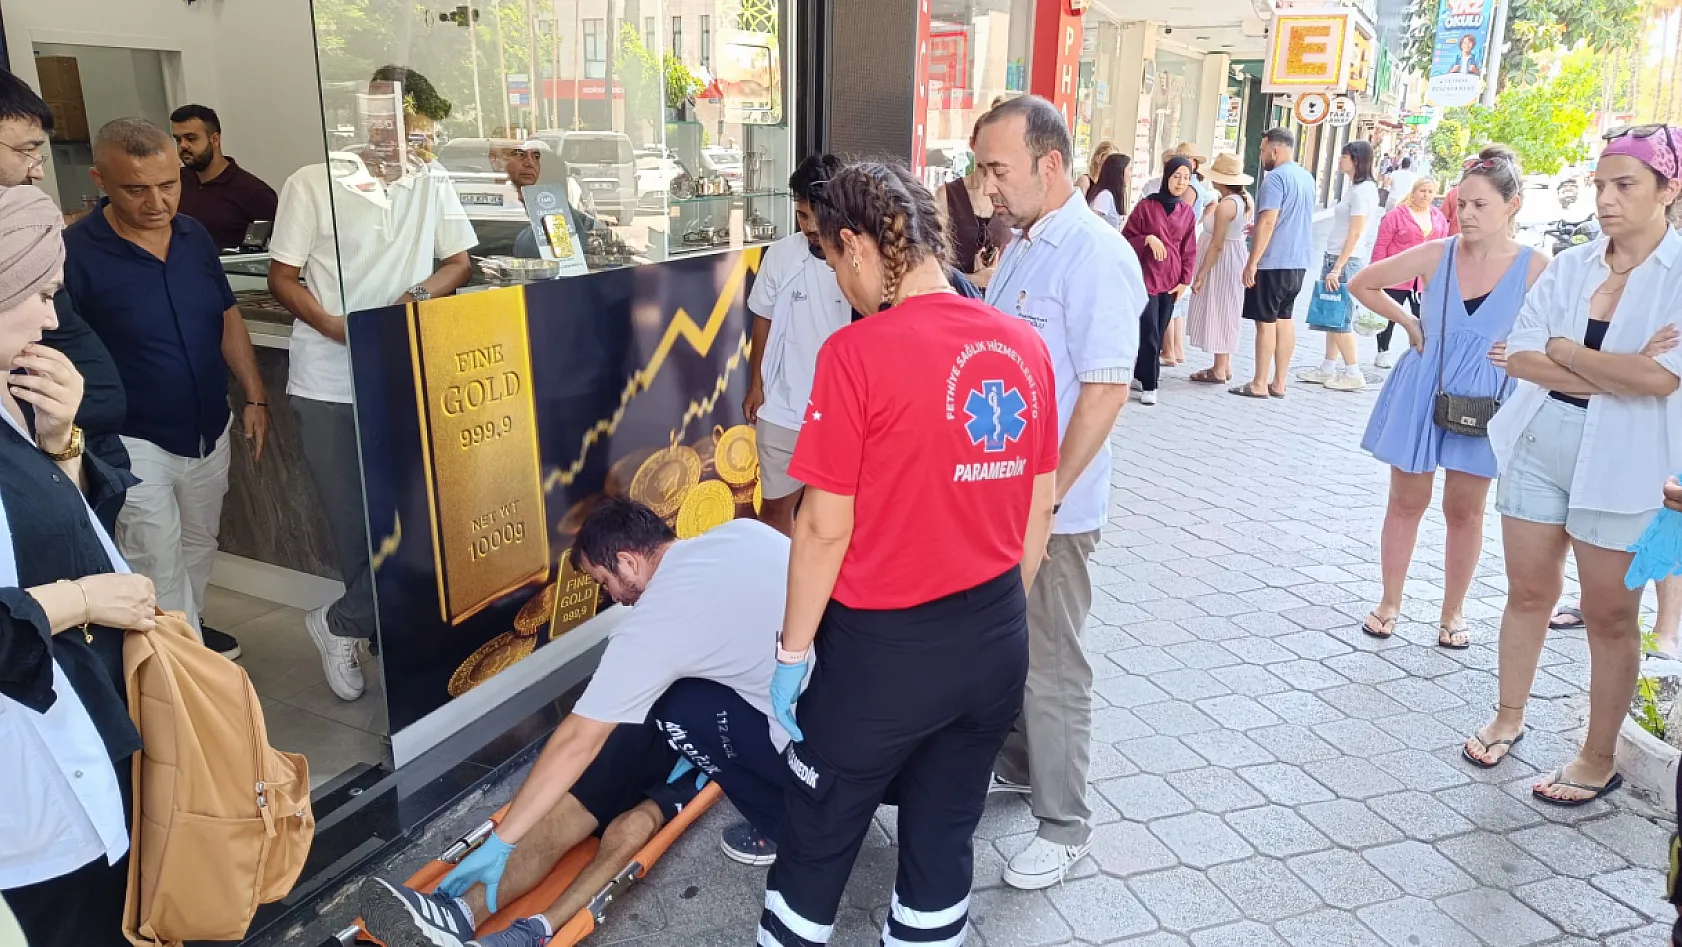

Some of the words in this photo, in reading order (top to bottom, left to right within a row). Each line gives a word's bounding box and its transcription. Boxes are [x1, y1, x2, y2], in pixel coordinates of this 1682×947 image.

[1285, 25, 1331, 75] E
[455, 344, 504, 373] FINE
[441, 370, 520, 417] GOLD
[946, 366, 961, 420] FETHİYE
[956, 341, 986, 368] SAĞLIK
[987, 339, 1036, 388] HİZMETLERİ
[953, 456, 1027, 482] PARAMEDİK
[472, 510, 496, 532] NET
[500, 499, 519, 518] WT
[468, 521, 526, 562] 1000g
[561, 588, 592, 608] GOLD
[566, 574, 592, 592] FINE
[716, 710, 728, 732] 112
